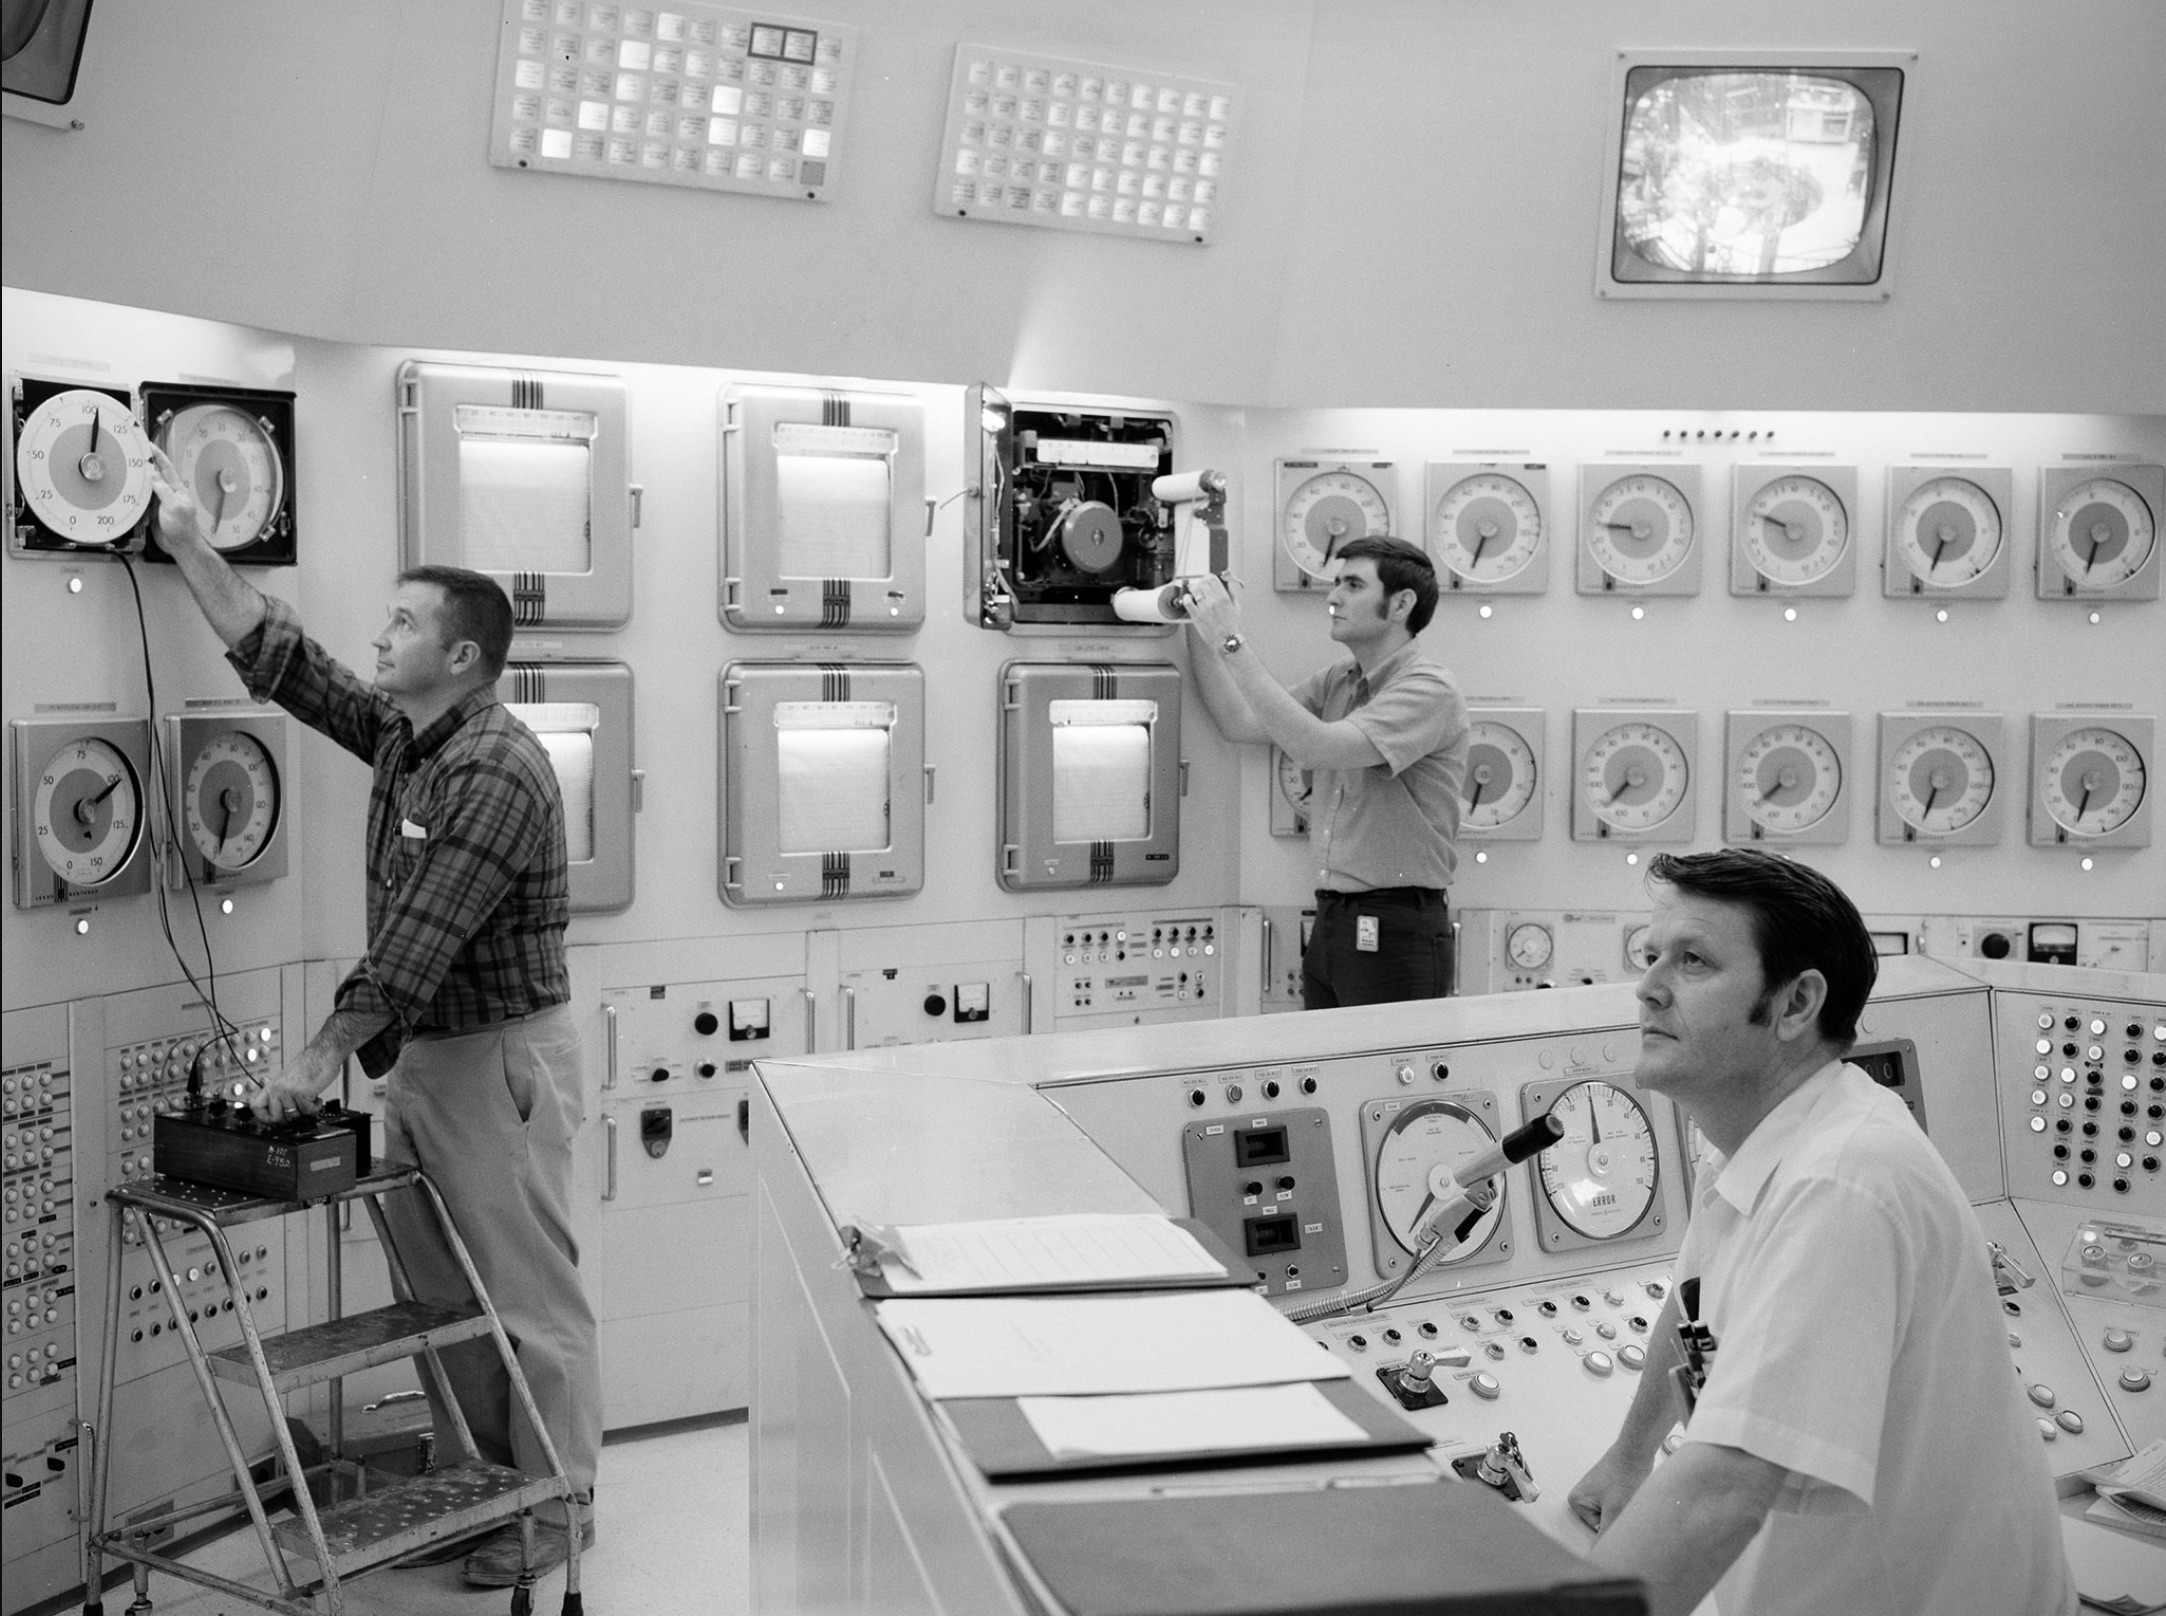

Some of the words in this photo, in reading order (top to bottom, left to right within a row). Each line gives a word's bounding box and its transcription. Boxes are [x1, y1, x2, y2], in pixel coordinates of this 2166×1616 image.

[82, 405, 97, 414] 100
[50, 418, 61, 428] 75
[114, 425, 127, 434] 125
[32, 450, 44, 460] 50
[128, 459, 143, 468] 150
[41, 490, 53, 499] 25
[123, 495, 136, 504] 175
[69, 516, 76, 525] 0
[97, 516, 114, 525] 200
[76, 750, 86, 760] 75
[44, 776, 54, 786] 50
[113, 820, 125, 830] 125
[38, 826, 48, 836] 25
[66, 860, 73, 870] 0
[90, 856, 103, 866] 150
[1884, 1062, 1892, 1080] 0
[1607, 1100, 1614, 1108] 20
[266, 1154, 290, 1168] E-952
[1592, 1194, 1616, 1207] ERROR
